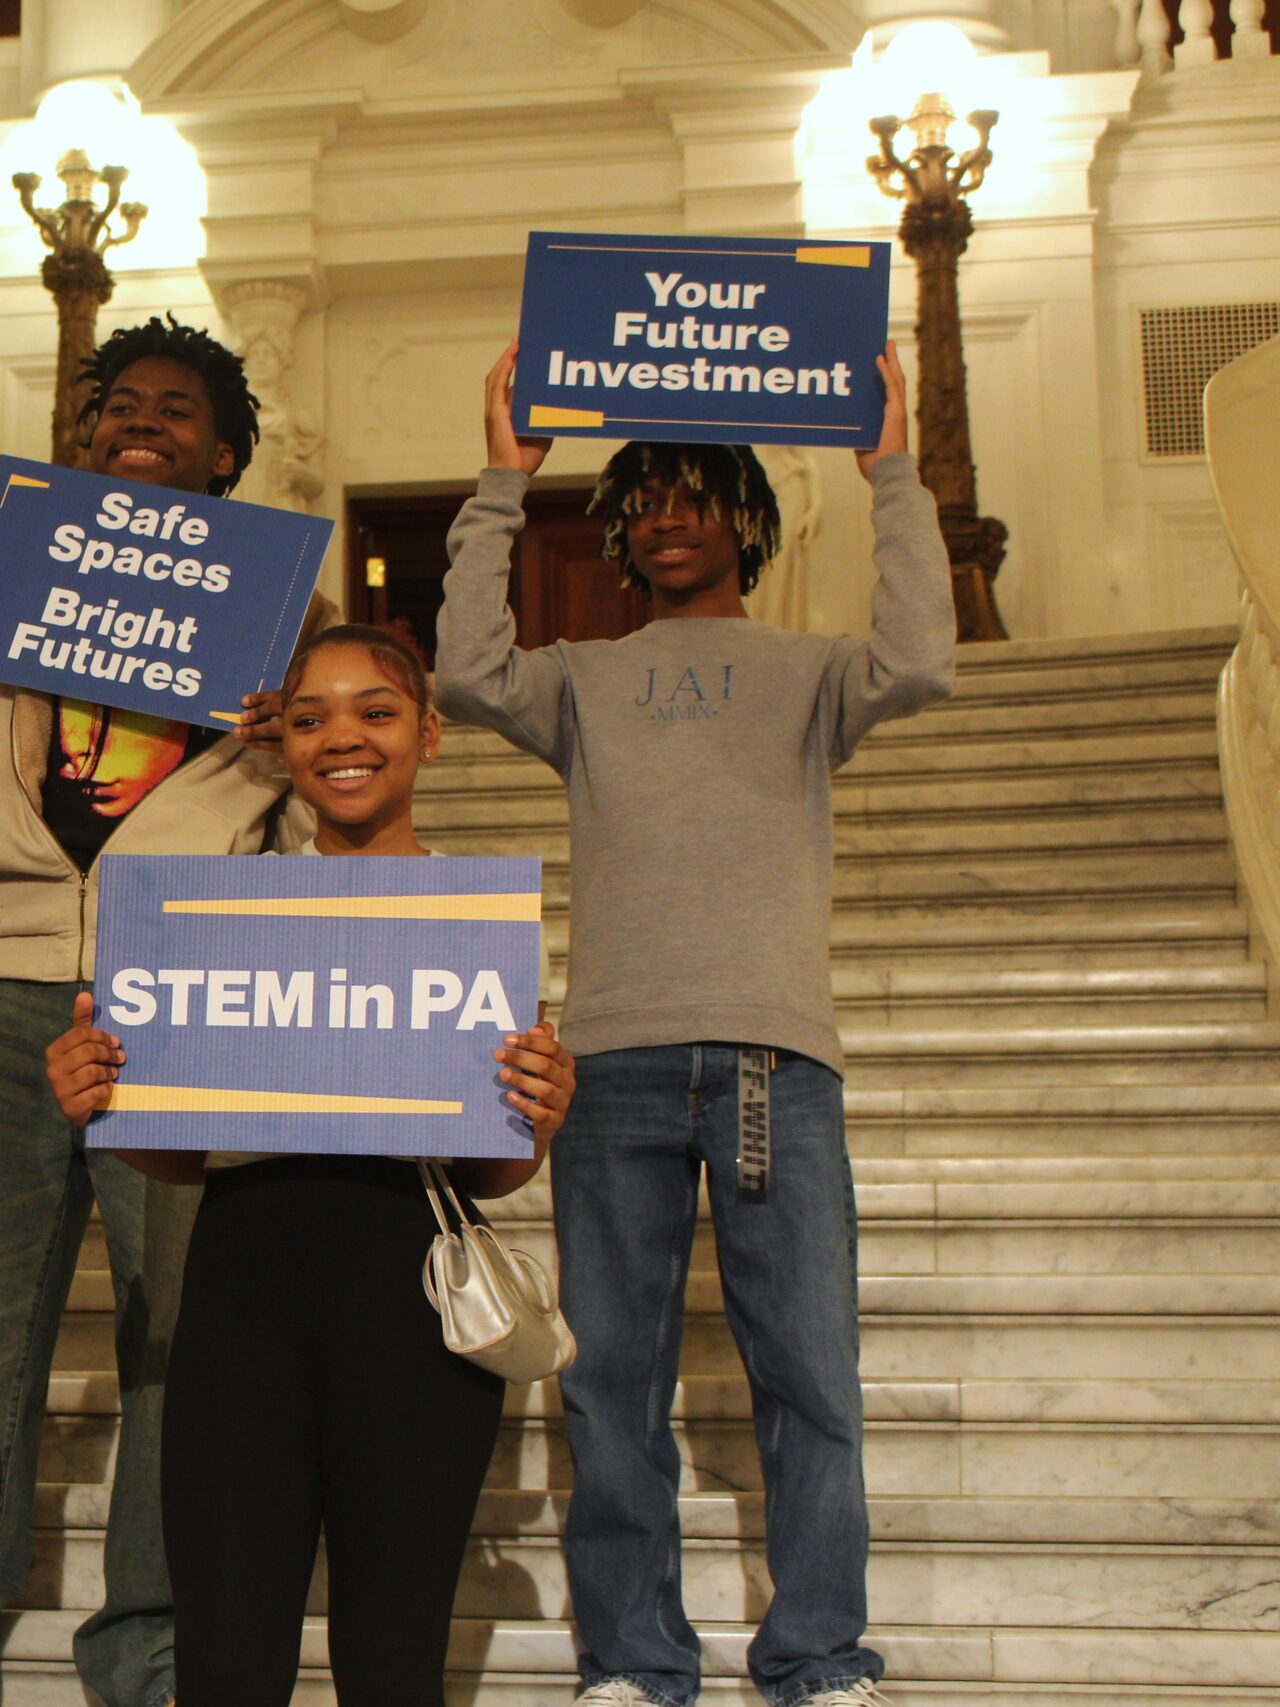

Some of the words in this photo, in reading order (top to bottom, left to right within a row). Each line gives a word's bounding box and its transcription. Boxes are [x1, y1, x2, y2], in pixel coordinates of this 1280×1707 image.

[644, 272, 766, 309] Your
[613, 311, 791, 352] Future
[547, 350, 852, 396] Investment
[95, 491, 210, 546] Safe
[47, 523, 233, 593] Spaces
[40, 586, 199, 654] Bright
[7, 622, 203, 697] Futures
[634, 664, 735, 707] JAI
[108, 967, 315, 1029] STEM
[328, 967, 395, 1030] in
[410, 968, 518, 1032] PA
